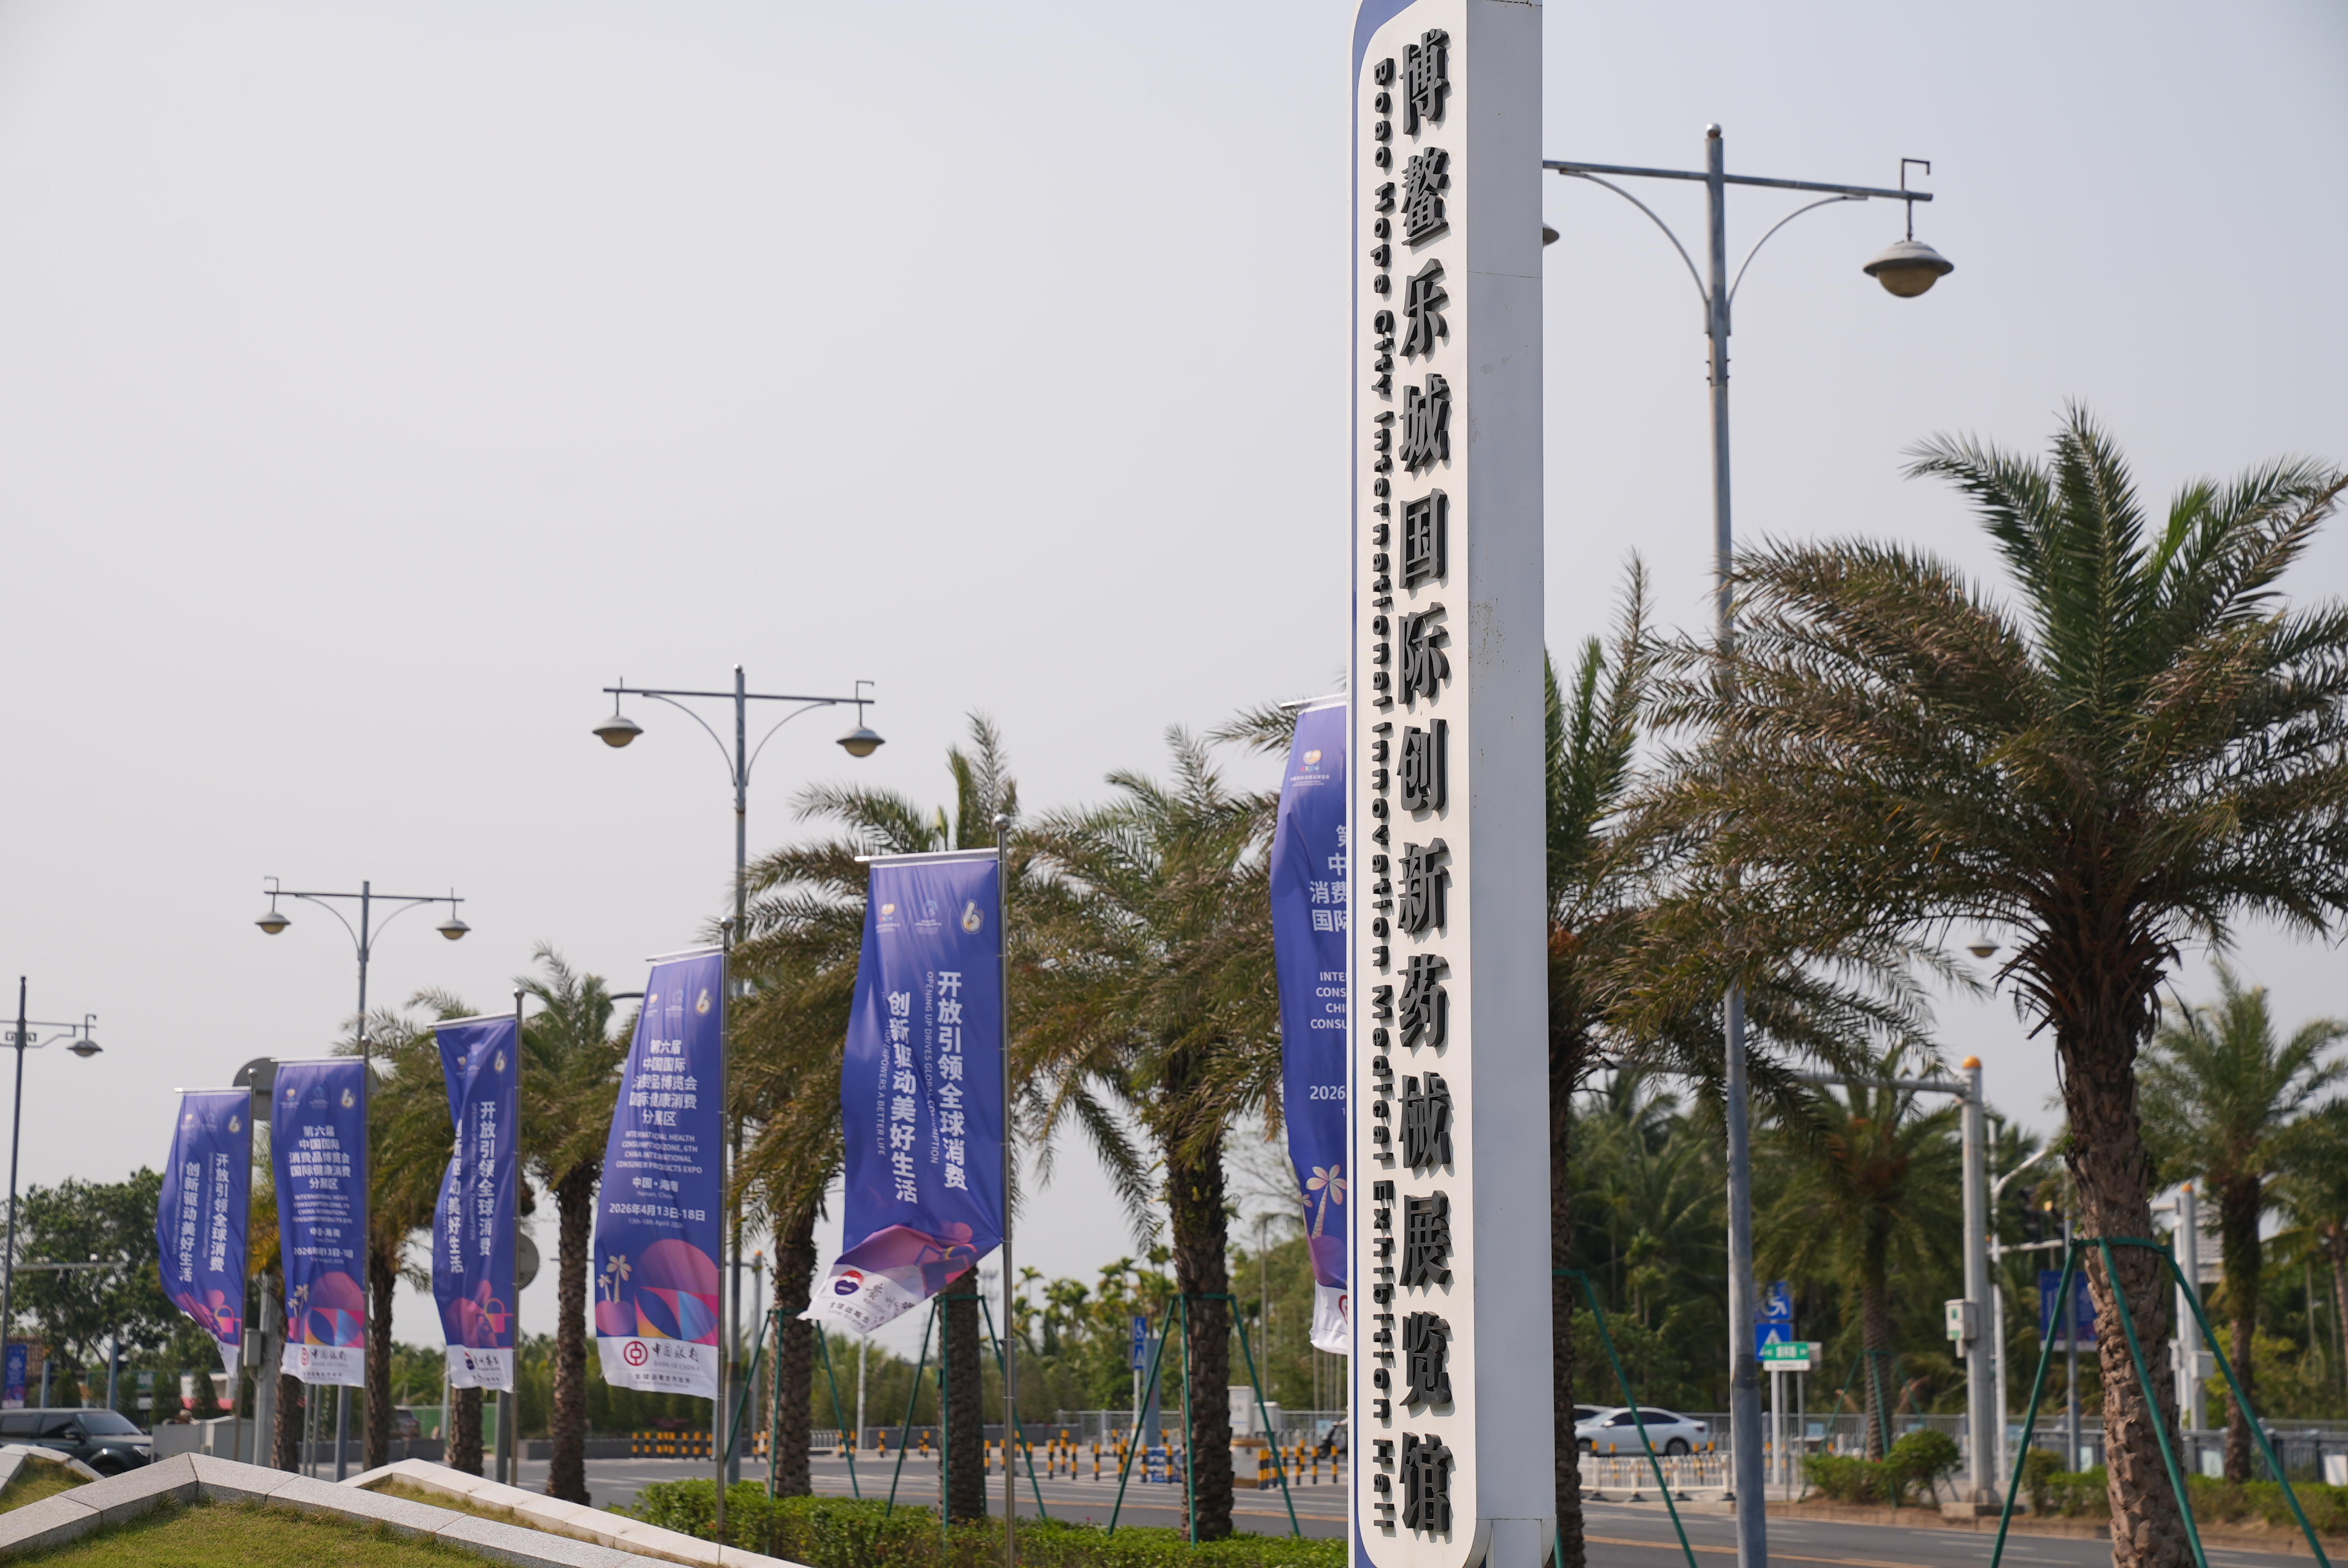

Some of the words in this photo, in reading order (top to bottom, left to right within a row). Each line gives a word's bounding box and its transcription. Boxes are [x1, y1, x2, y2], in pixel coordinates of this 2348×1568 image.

[1374, 58, 1394, 168] Boao
[1371, 182, 1394, 294] Hope
[1372, 310, 1394, 395] City
[1373, 411, 1394, 707] International
[1398, 29, 1451, 1532] 博鳌乐城国际创新药械展览馆
[1372, 722, 1392, 967] Innovation
[924, 1014, 933, 1027] UP
[925, 971, 934, 1012] OPENING
[1319, 971, 1347, 982] INTE
[1325, 1003, 1347, 1013] CHI
[642, 1056, 686, 1072] 中国国际
[887, 991, 918, 1204] 创新驱动美好生活
[924, 1028, 933, 1061] DRIVES
[938, 971, 968, 1191] 开放引领全球消费
[1372, 985, 1393, 1159] Medical
[209, 1152, 230, 1273] 开放引领全球消费
[477, 1100, 497, 1256] 开放引领全球消费
[652, 1342, 699, 1363] 中国银行
[1373, 1180, 1394, 1418] Exhibition
[1373, 1439, 1394, 1528] Hall
